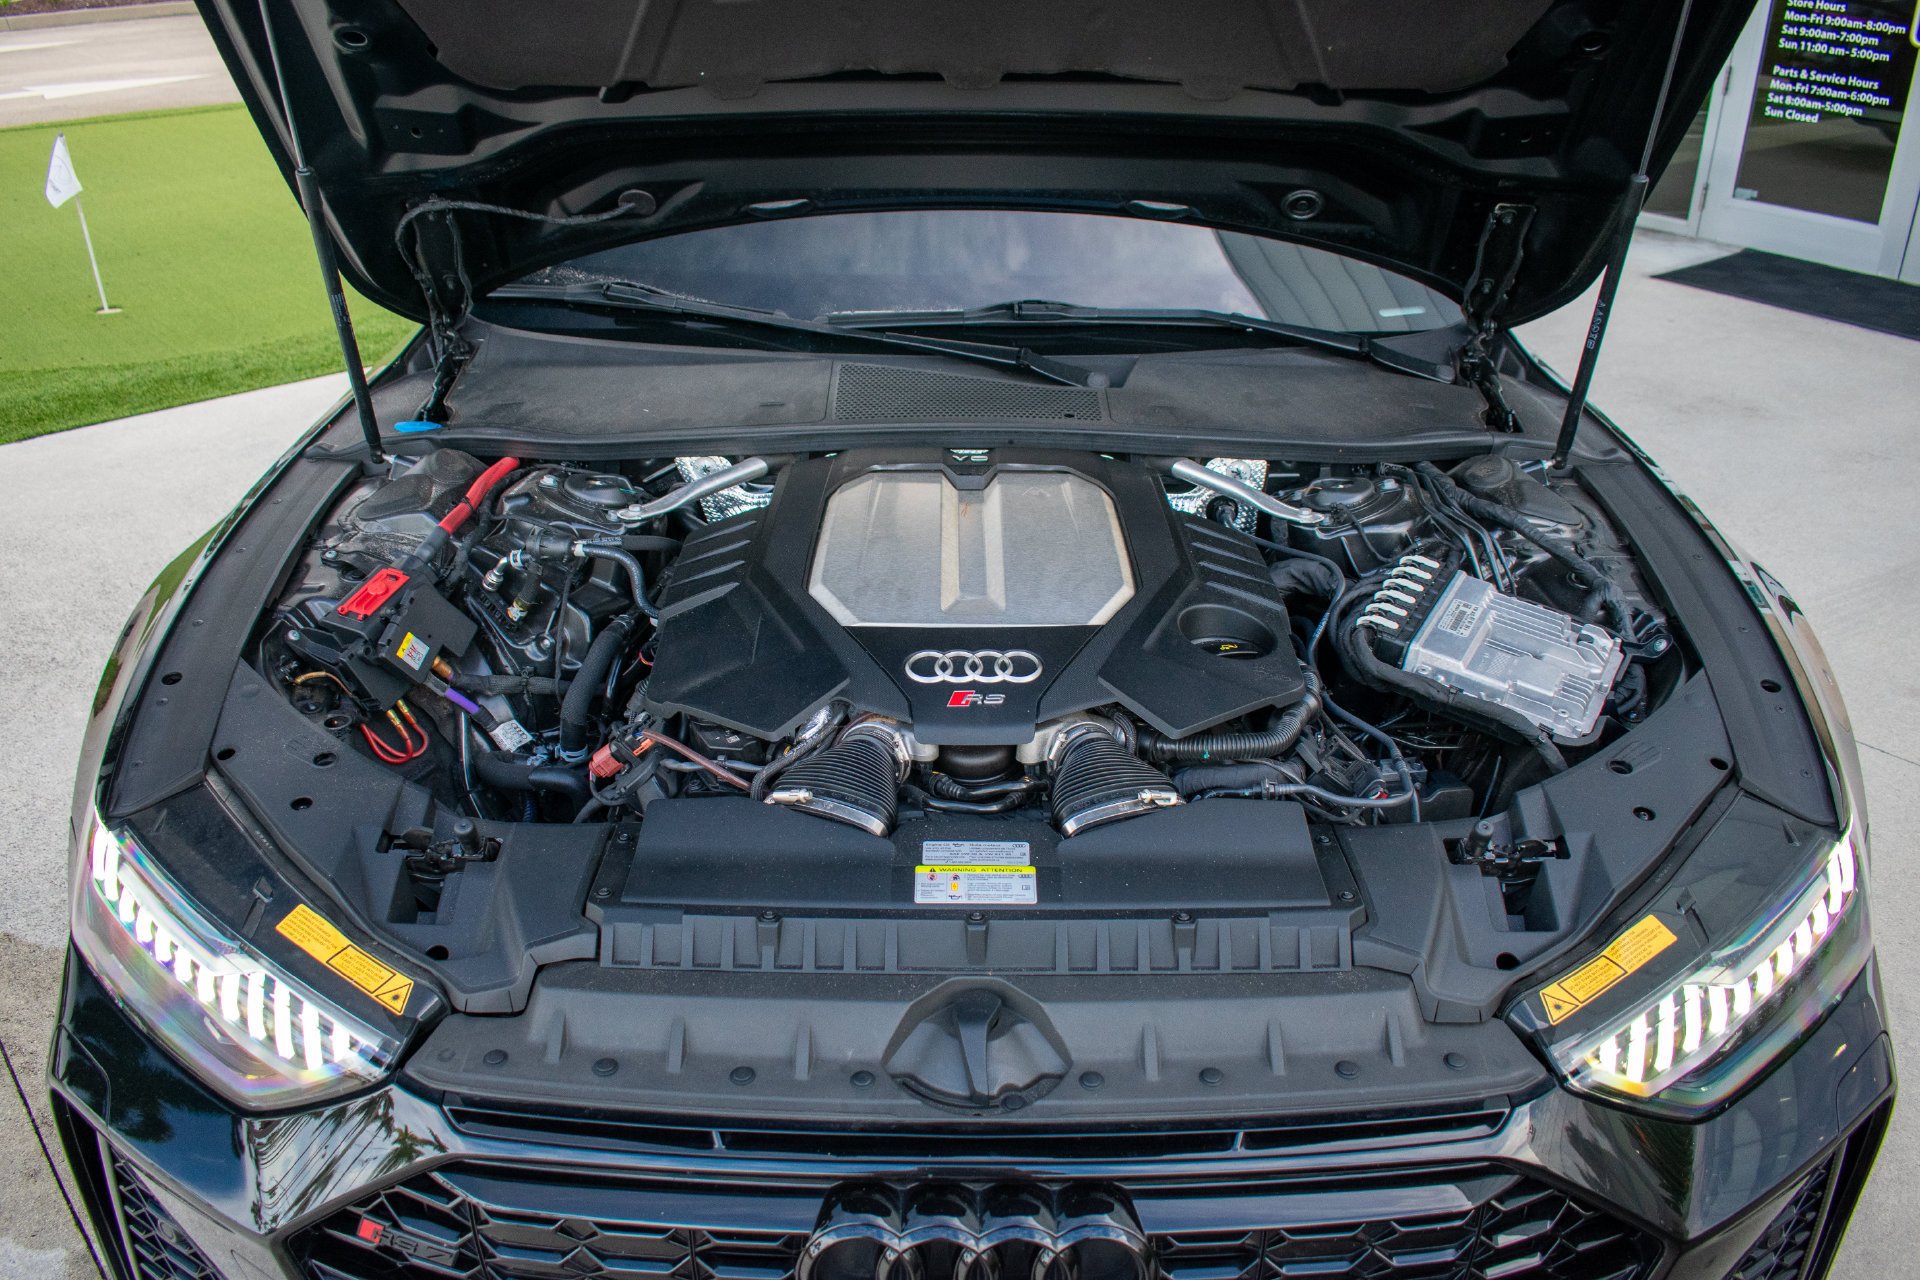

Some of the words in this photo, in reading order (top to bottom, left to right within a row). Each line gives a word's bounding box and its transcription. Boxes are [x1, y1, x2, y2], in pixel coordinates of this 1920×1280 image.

[1786, 0, 1814, 9] Store
[1815, 0, 1847, 12] Hours
[1784, 10, 1825, 24] Mon-Fri
[1825, 15, 1906, 34] 9:00am-8:00pm
[1778, 37, 1798, 49] Sun
[1800, 40, 1828, 53] 11:00
[1781, 24, 1798, 35] Sat
[1799, 26, 1879, 46] 9:00am-7:00pm
[1773, 64, 1799, 79] Parts
[1800, 68, 1809, 79] &
[1810, 70, 1847, 85] Service
[1848, 76, 1880, 90] Hours
[1770, 79, 1810, 94] Mon-Fri
[1811, 85, 1890, 106] 7:00am-6:00pm
[1764, 105, 1784, 118] Sun
[1785, 110, 1819, 123] Closed
[1767, 92, 1784, 104] Sat
[1785, 95, 1863, 116] 8:00am-5:00pm
[960, 693, 1006, 705] RS
